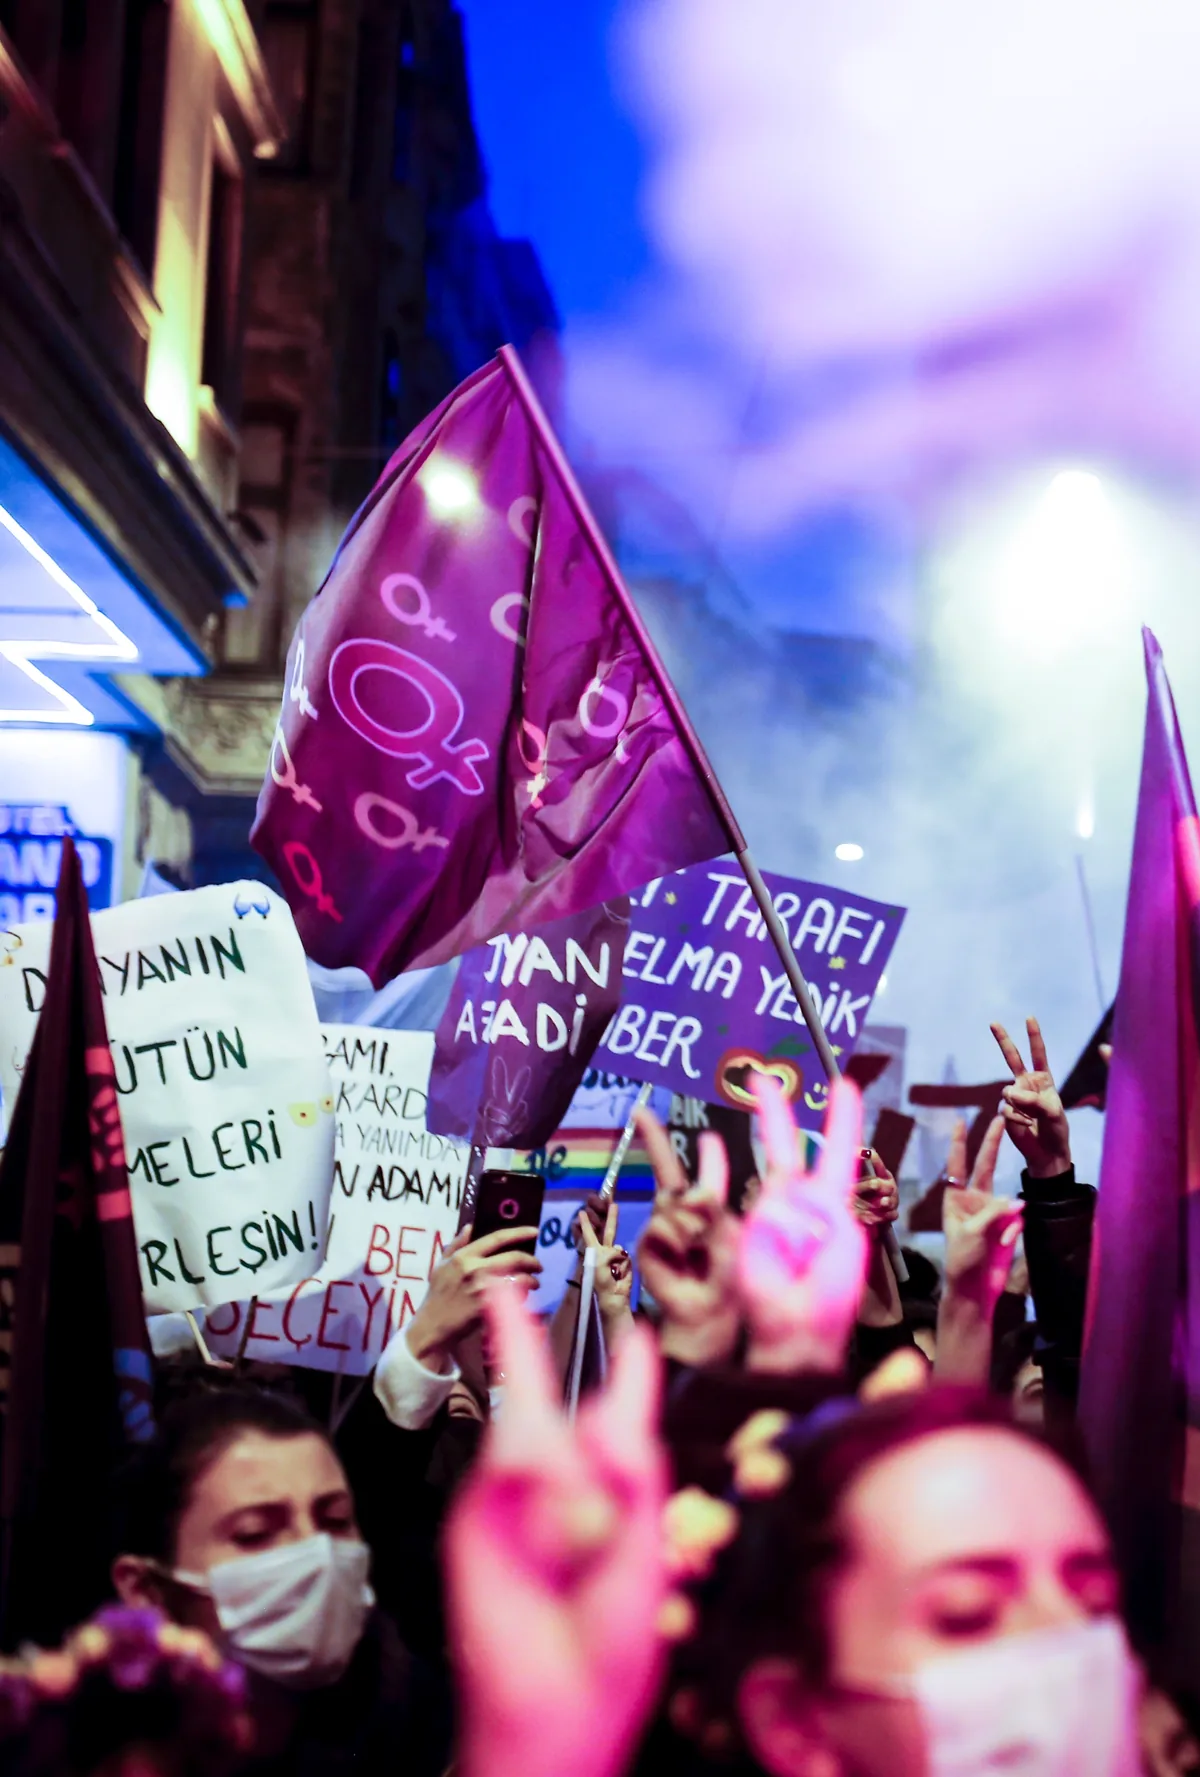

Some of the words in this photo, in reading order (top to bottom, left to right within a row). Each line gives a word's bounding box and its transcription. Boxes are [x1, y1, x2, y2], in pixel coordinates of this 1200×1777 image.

[22, 927, 246, 1012] DYANIN
[622, 931, 742, 998] ELMA
[109, 1026, 247, 1094] ÜTÜN
[126, 1109, 282, 1187] MELERİ
[141, 1201, 319, 1287] RLEŞİN!
